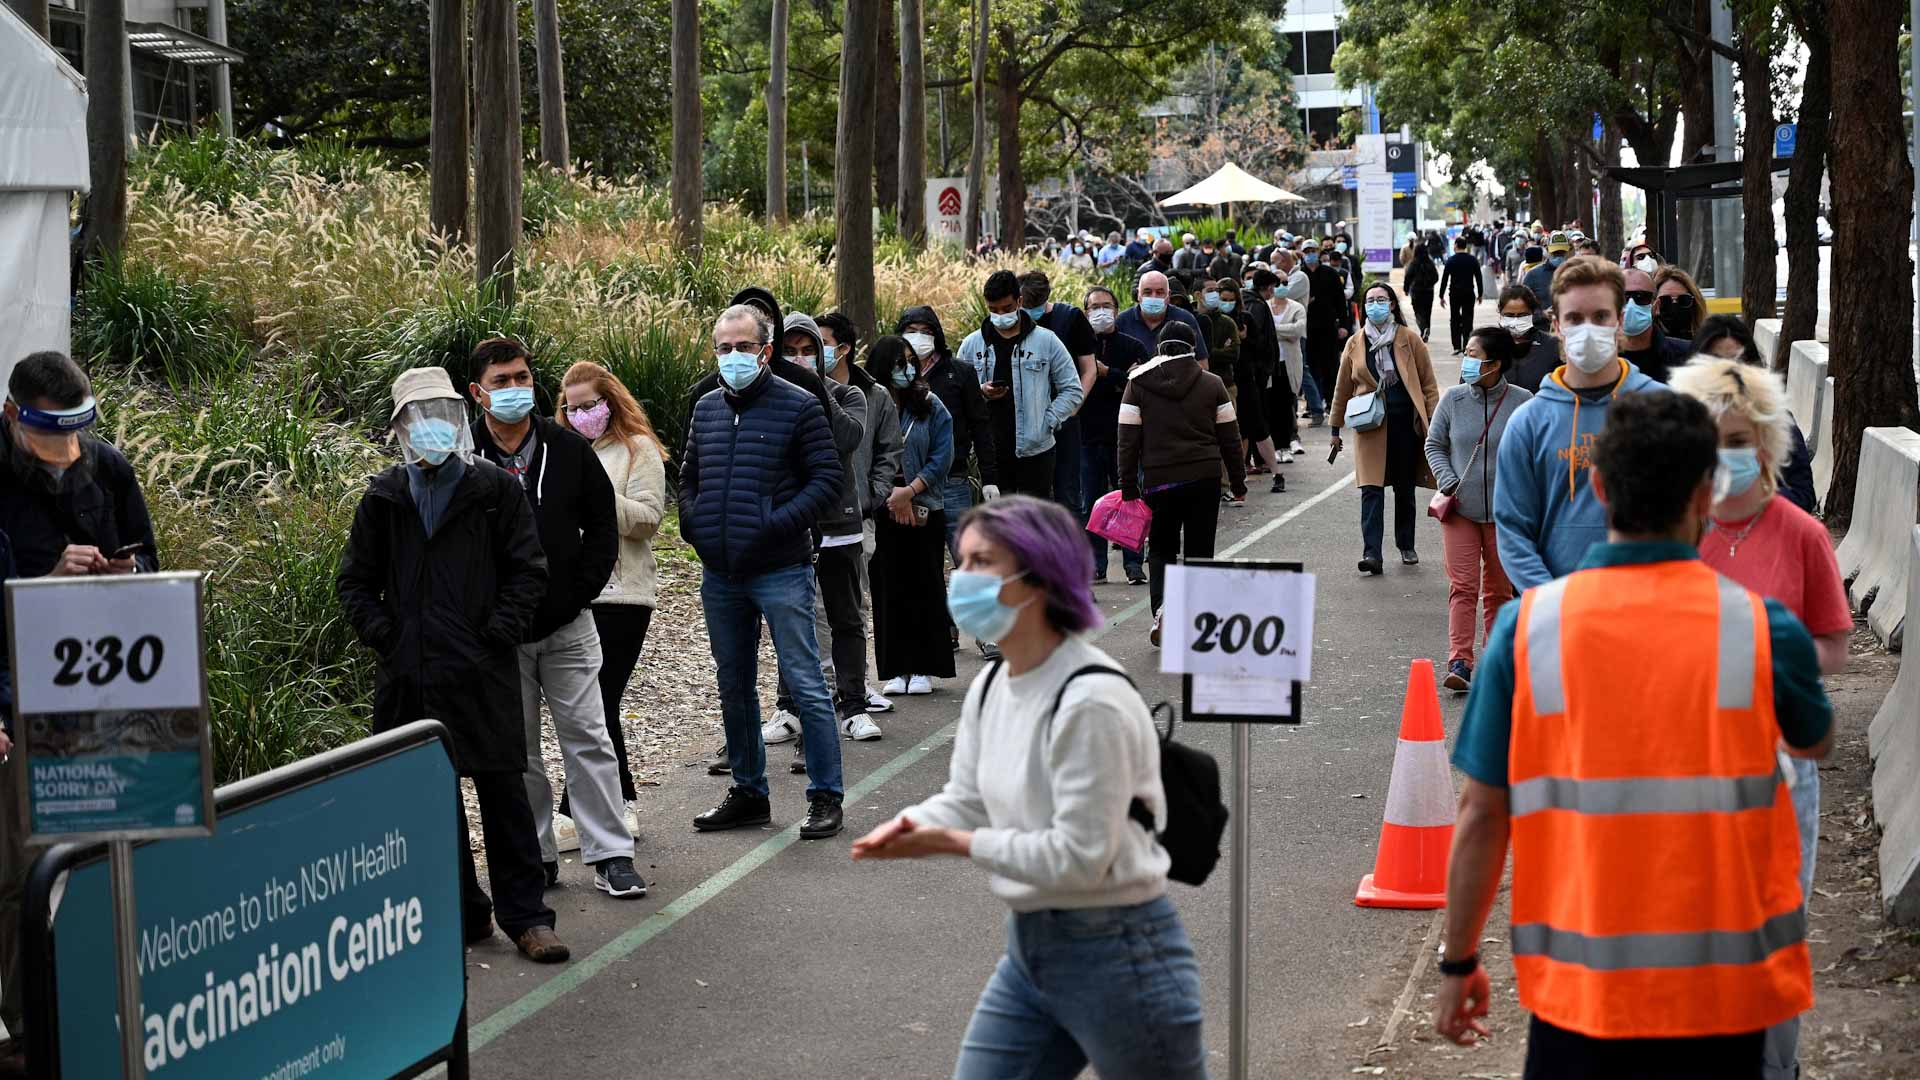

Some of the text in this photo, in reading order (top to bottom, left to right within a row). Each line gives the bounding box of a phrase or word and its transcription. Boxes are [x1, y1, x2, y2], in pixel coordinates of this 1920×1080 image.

[1557, 447, 1592, 460] NOR
[1581, 433, 1600, 447] TH
[1191, 612, 1285, 656] 2:00
[53, 634, 164, 687] 2:30
[34, 763, 118, 780] NATIONAL
[34, 778, 128, 798] SORRY DAY
[136, 828, 407, 976] Welcome to the NSW Health
[327, 896, 423, 981] Centre
[261, 1032, 346, 1080] ointment only
